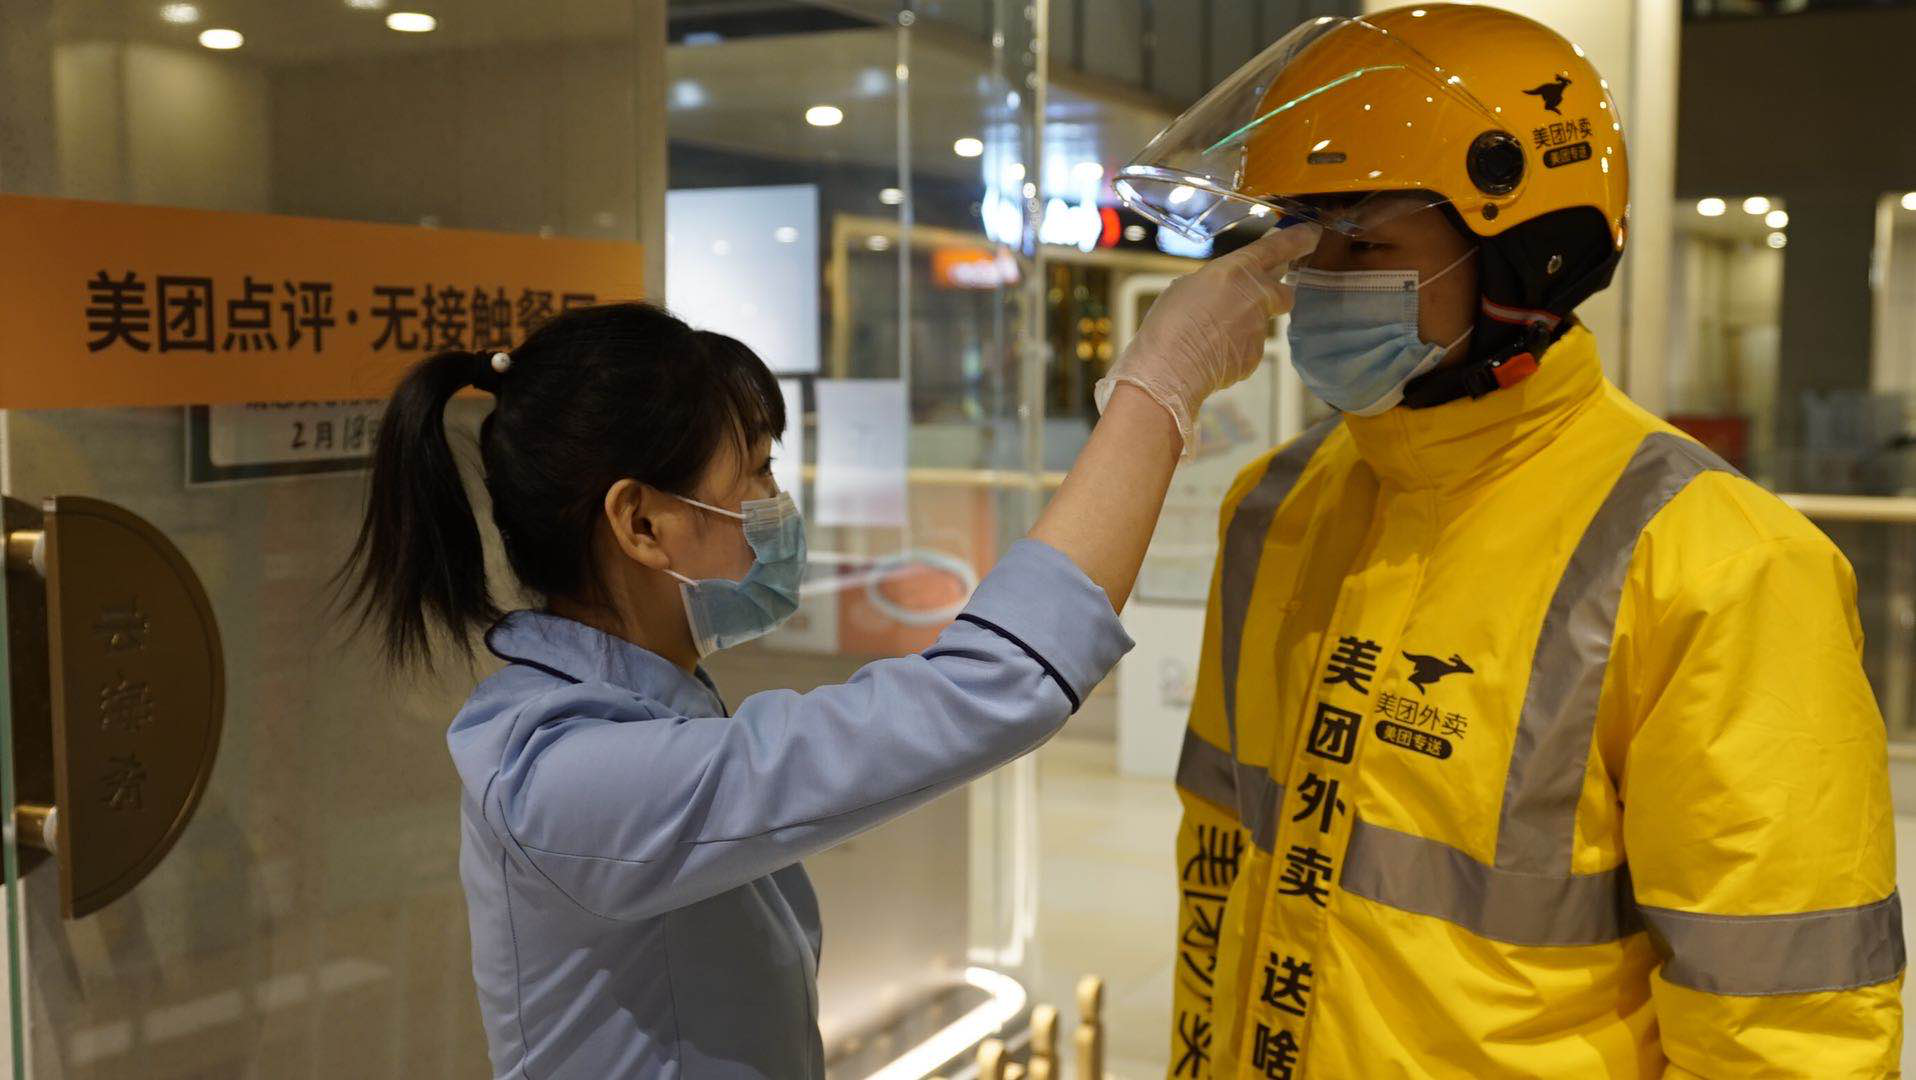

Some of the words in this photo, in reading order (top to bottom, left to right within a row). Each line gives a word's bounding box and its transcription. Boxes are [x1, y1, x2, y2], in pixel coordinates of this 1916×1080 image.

[1532, 117, 1593, 149] 美团外卖
[85, 270, 597, 353] 美团点评·无接触餐
[1375, 692, 1468, 740] 美团外卖
[1384, 724, 1442, 757] 美团专送
[1278, 636, 1382, 908] 美团外卖
